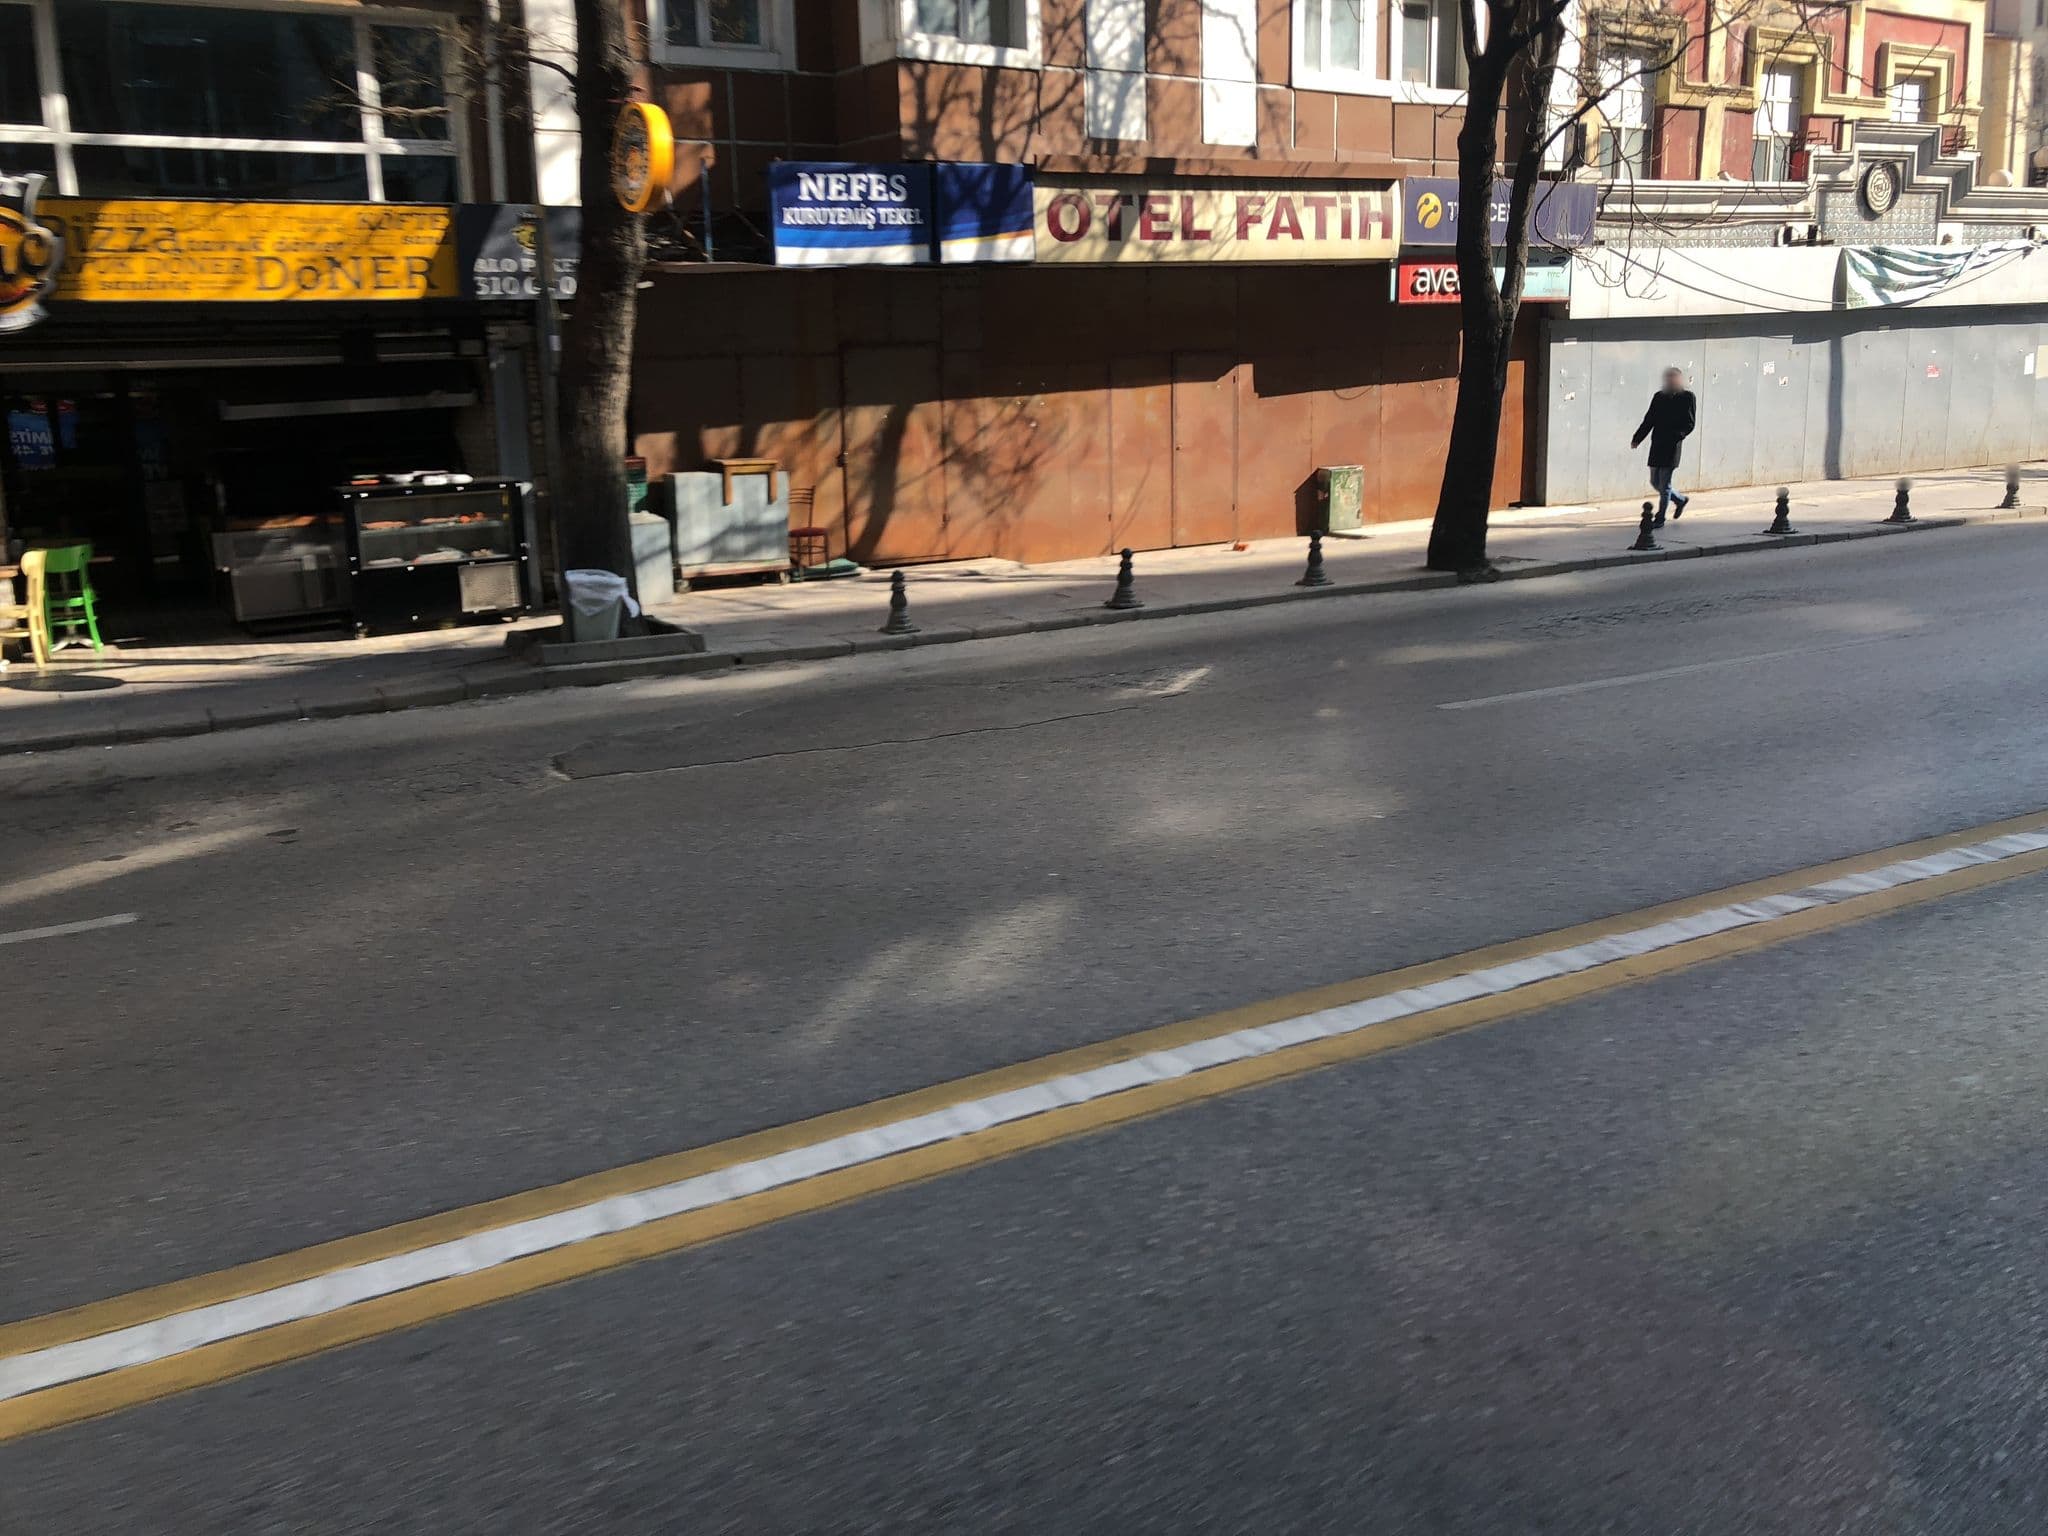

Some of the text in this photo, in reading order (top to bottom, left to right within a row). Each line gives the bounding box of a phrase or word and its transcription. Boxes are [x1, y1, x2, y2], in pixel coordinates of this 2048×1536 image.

[797, 172, 908, 202] NEFES
[1047, 193, 1212, 243] OTEL
[1414, 266, 1460, 294] ave
